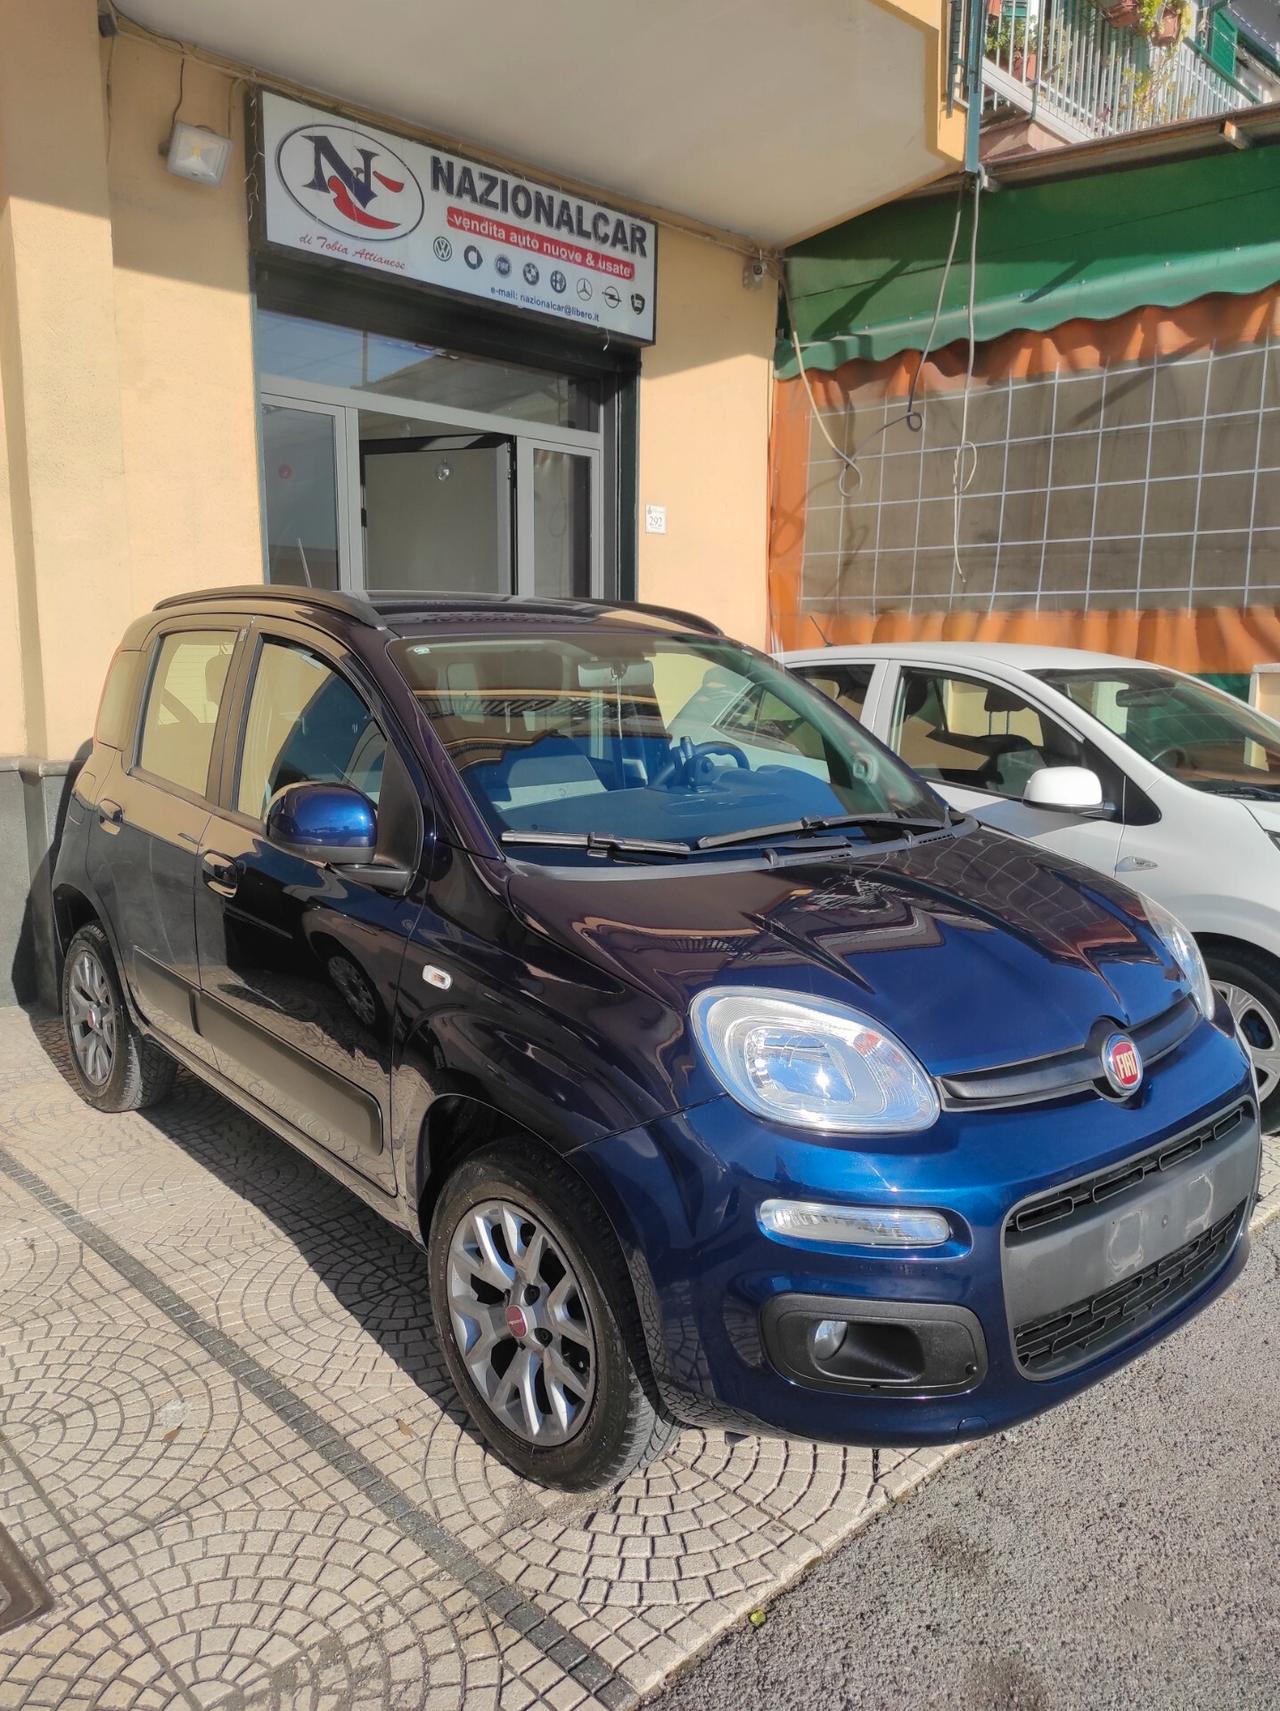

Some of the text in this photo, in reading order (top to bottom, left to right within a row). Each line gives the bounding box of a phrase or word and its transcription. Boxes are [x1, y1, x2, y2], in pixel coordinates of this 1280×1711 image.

[431, 155, 648, 258] NAZIONALCAR
[299, 234, 313, 245] di
[317, 236, 349, 255] Tobia
[453, 214, 633, 277] vendita auto nuove & usate
[490, 286, 600, 322] e-mail: nazionalcar@libero.it
[1115, 1050, 1137, 1079] FIAT
